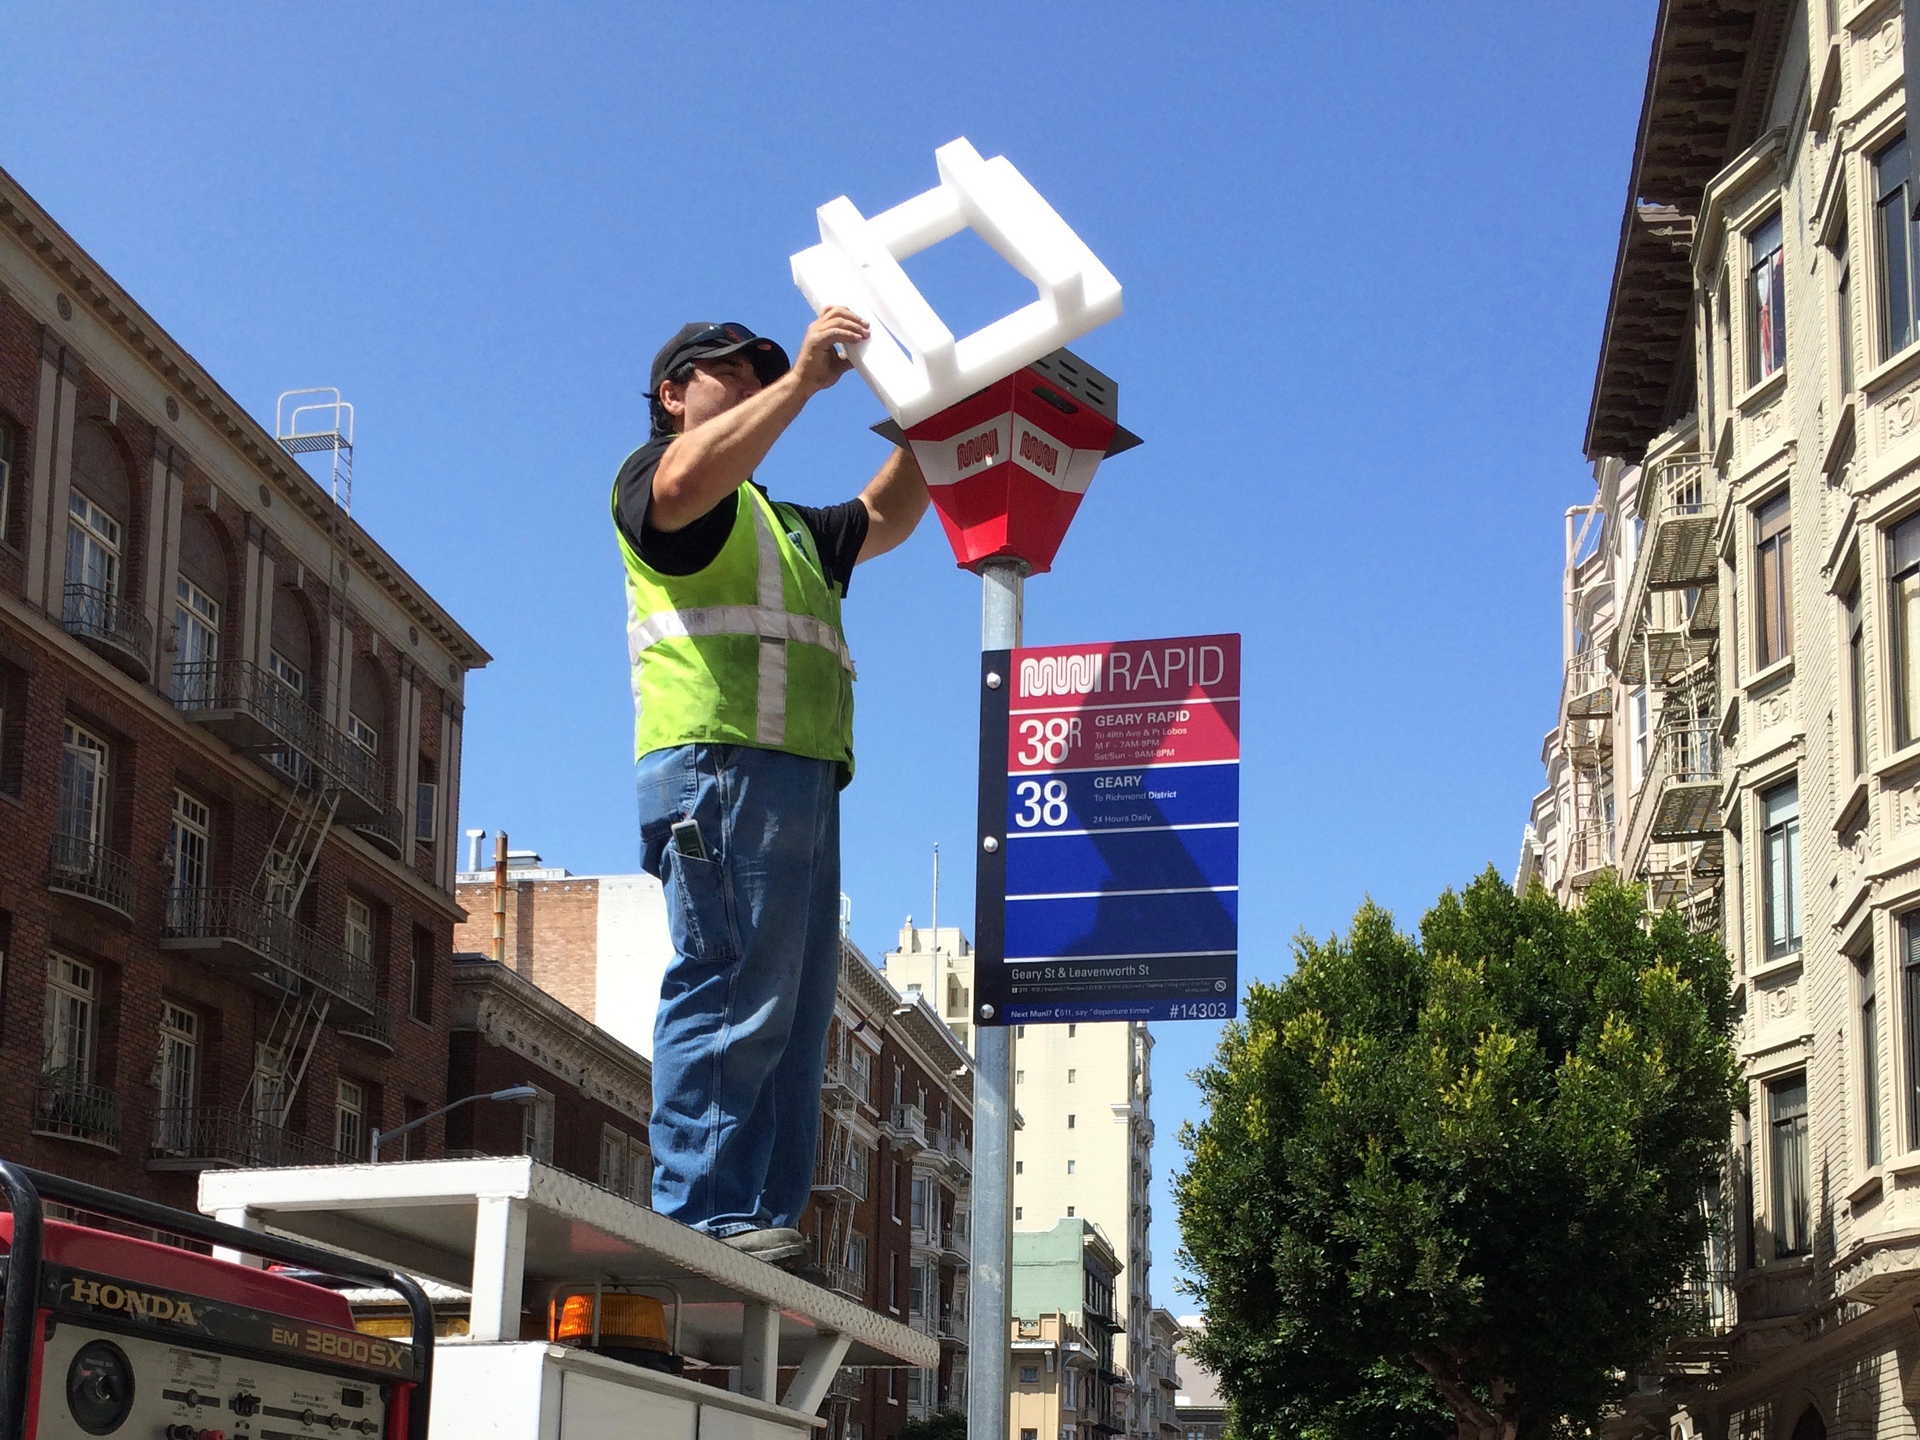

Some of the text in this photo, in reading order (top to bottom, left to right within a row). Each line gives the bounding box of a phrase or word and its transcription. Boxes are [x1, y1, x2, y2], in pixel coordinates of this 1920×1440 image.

[1108, 645, 1224, 692] RAPID
[1095, 710, 1190, 727] GEARY RAPID
[1095, 731, 1104, 740] To
[1106, 730, 1124, 739] 48th
[1126, 730, 1140, 738] Ave
[1143, 729, 1150, 737] &
[1162, 727, 1188, 736] Lobos
[1119, 739, 1160, 748] 7AM-9PM
[1094, 775, 1142, 789] GEARY
[1014, 779, 1069, 828] 38
[1094, 790, 1177, 802] To Richmond District
[1093, 814, 1152, 824] 24 Hours Daily
[1011, 964, 1150, 981] Geary St & Leavenworth St
[1010, 1010, 1029, 1018] Next
[1169, 1002, 1227, 1019] #14303
[70, 1277, 198, 1326] HONDA
[271, 1327, 403, 1370] EM 3800SX
